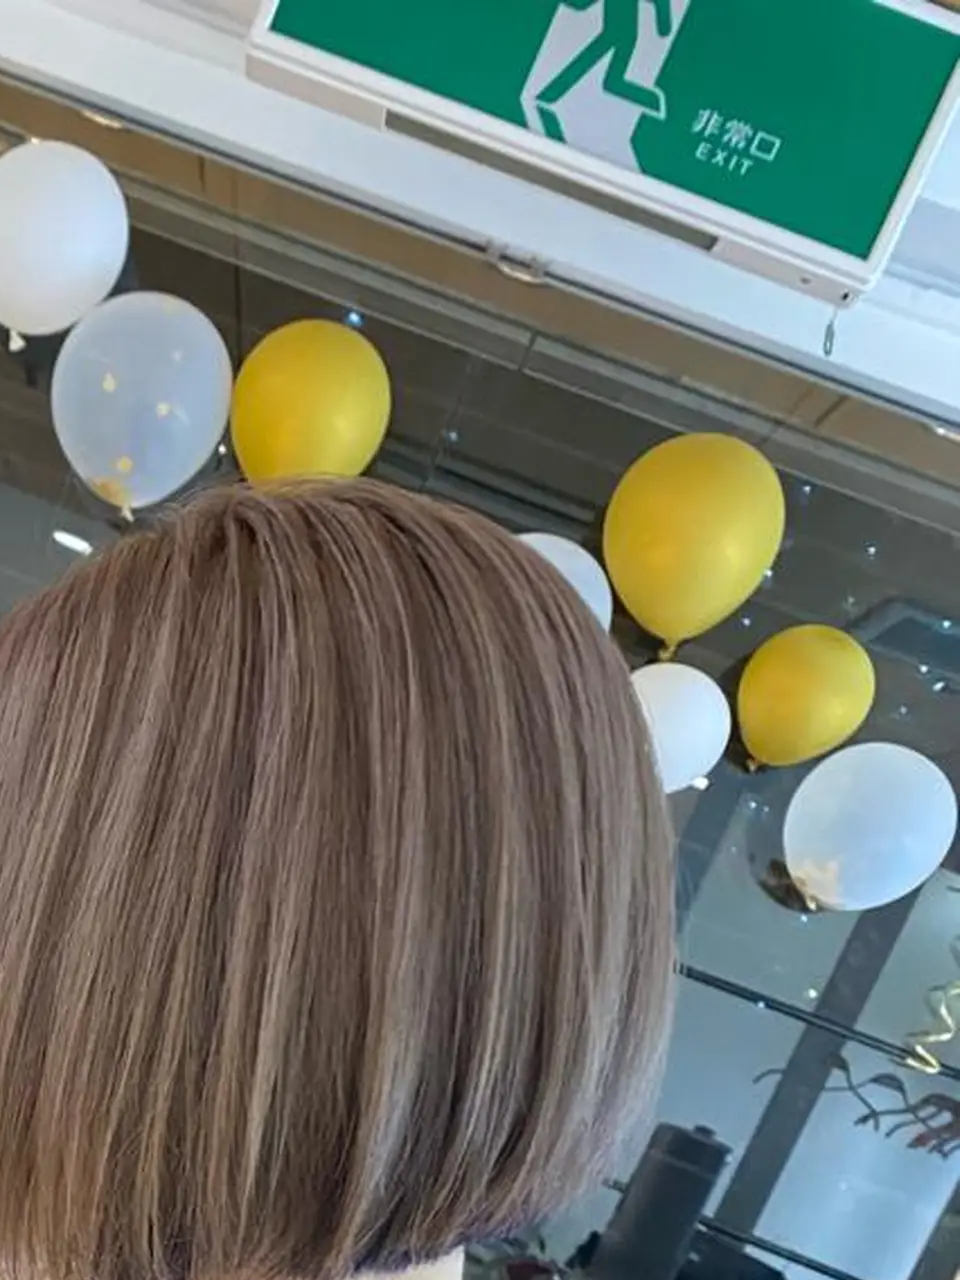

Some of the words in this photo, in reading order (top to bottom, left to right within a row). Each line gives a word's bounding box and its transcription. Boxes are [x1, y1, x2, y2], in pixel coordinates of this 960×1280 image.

[692, 108, 782, 162] 非常口
[695, 141, 753, 176] EXIT
